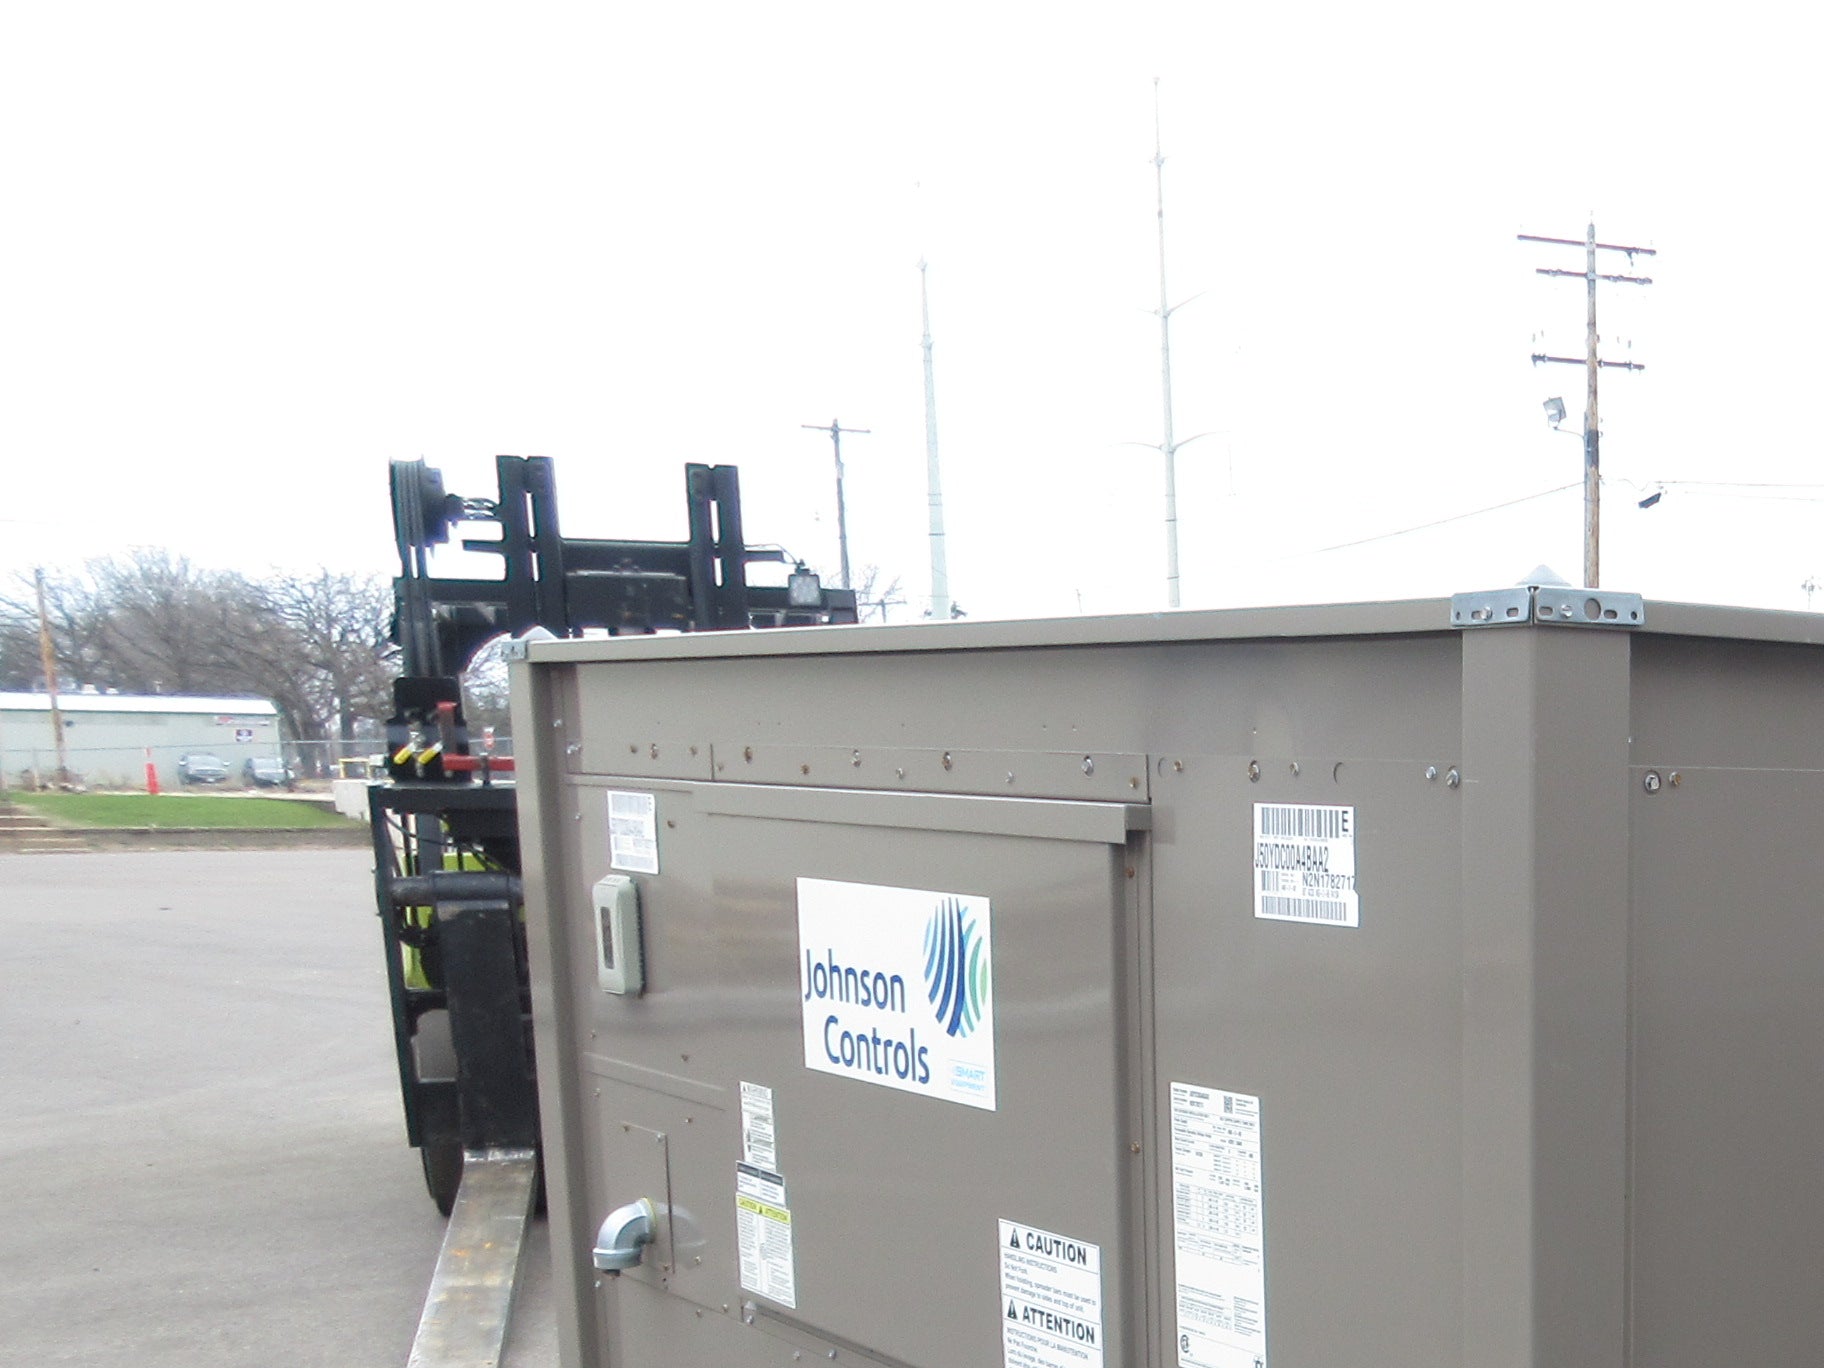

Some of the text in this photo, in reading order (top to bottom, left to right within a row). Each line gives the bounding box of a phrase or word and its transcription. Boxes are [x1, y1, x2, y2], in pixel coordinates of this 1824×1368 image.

[1341, 810, 1349, 832] E
[805, 948, 905, 1014] Johnson
[824, 1015, 930, 1085] Controls
[1026, 1232, 1087, 1266] CAUTION
[1022, 1305, 1095, 1344] ATTENTION
